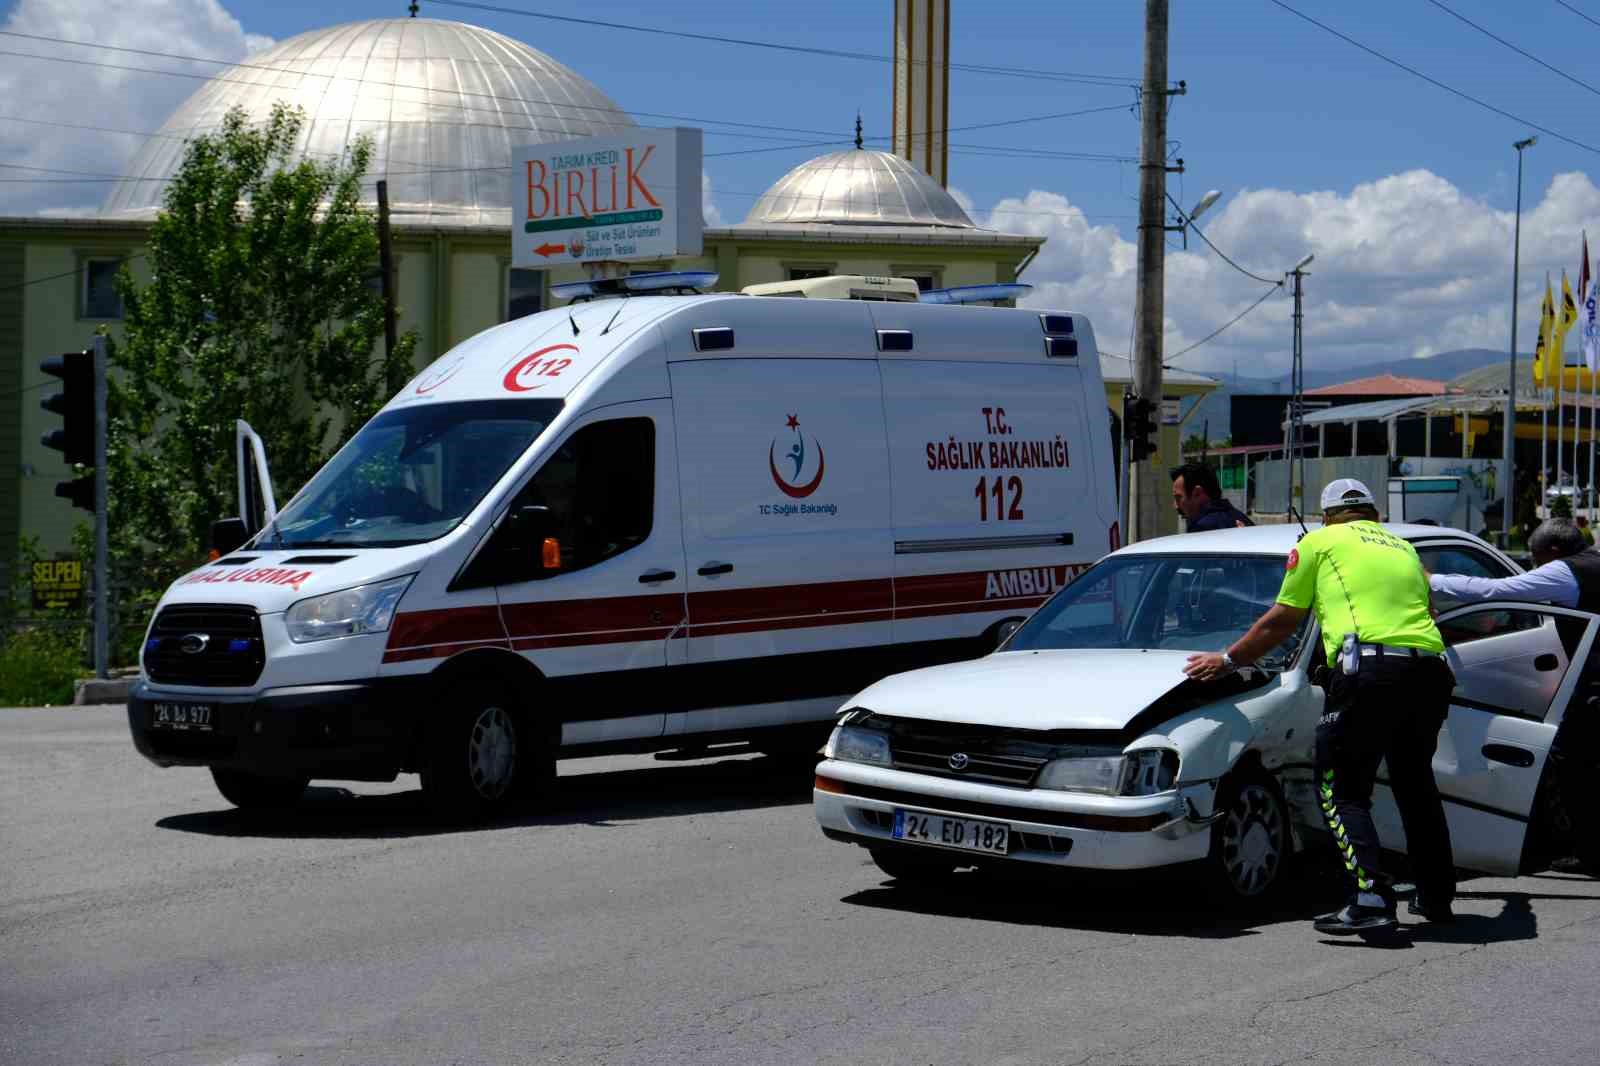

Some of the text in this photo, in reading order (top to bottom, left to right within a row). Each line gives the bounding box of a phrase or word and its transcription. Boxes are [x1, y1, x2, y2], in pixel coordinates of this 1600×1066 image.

[524, 358, 573, 377] 112
[982, 407, 1013, 435] T.C.
[926, 434, 1070, 470] SAĞLIK BAKANLIĞI
[975, 475, 1024, 521] 112
[985, 566, 1090, 599] AMBULA
[907, 815, 1006, 851] 24 ED 182
